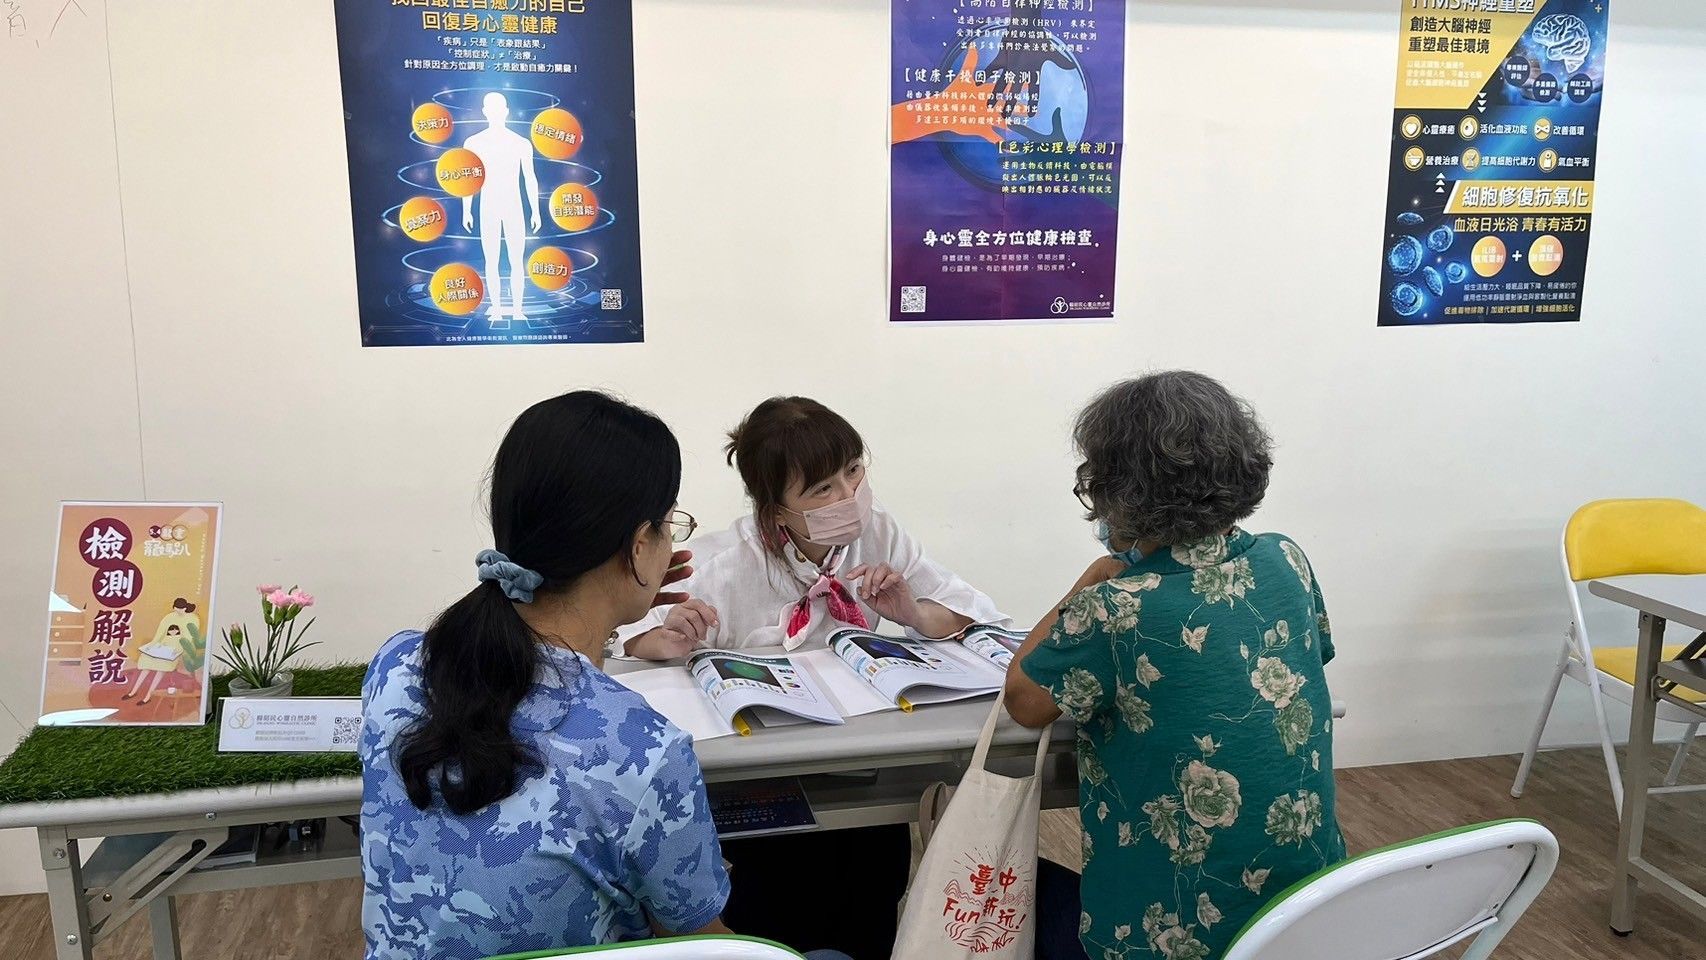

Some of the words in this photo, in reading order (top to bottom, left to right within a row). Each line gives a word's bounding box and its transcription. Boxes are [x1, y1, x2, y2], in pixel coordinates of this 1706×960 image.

[422, 11, 558, 34] 回復身心靈健康
[1410, 16, 1491, 34] 創造大腦神經
[1408, 37, 1490, 54] 重塑最佳環境
[904, 67, 1040, 85] 【健康干擾因子檢測】
[417, 117, 449, 131] 決策力
[1423, 125, 1455, 135] 心靈療癒
[1480, 124, 1528, 134] 活化血液功能
[1553, 125, 1585, 136] 改善循環
[535, 124, 576, 144] 穩定情緒
[998, 141, 1116, 155] 【色彩心理學檢測】
[1425, 155, 1459, 166] 營養治療
[1481, 156, 1536, 167] 提高細胞代謝力
[1558, 157, 1590, 168] 氣血平衡
[440, 167, 483, 180] 身心平衡
[562, 194, 582, 204] 開發
[1462, 186, 1589, 207] 細胞修復抗氧化
[555, 205, 595, 217] 自我潛能
[1454, 217, 1519, 232] 血液日光浴
[1522, 216, 1587, 232] 青春有活力
[923, 229, 1092, 247] 身心靈全方位健康檢查
[533, 262, 568, 276] 創造力
[445, 278, 465, 289] 良好
[438, 289, 479, 303] 人際關係
[84, 526, 134, 685] 檢測解說
[970, 864, 1018, 895] 臺中
